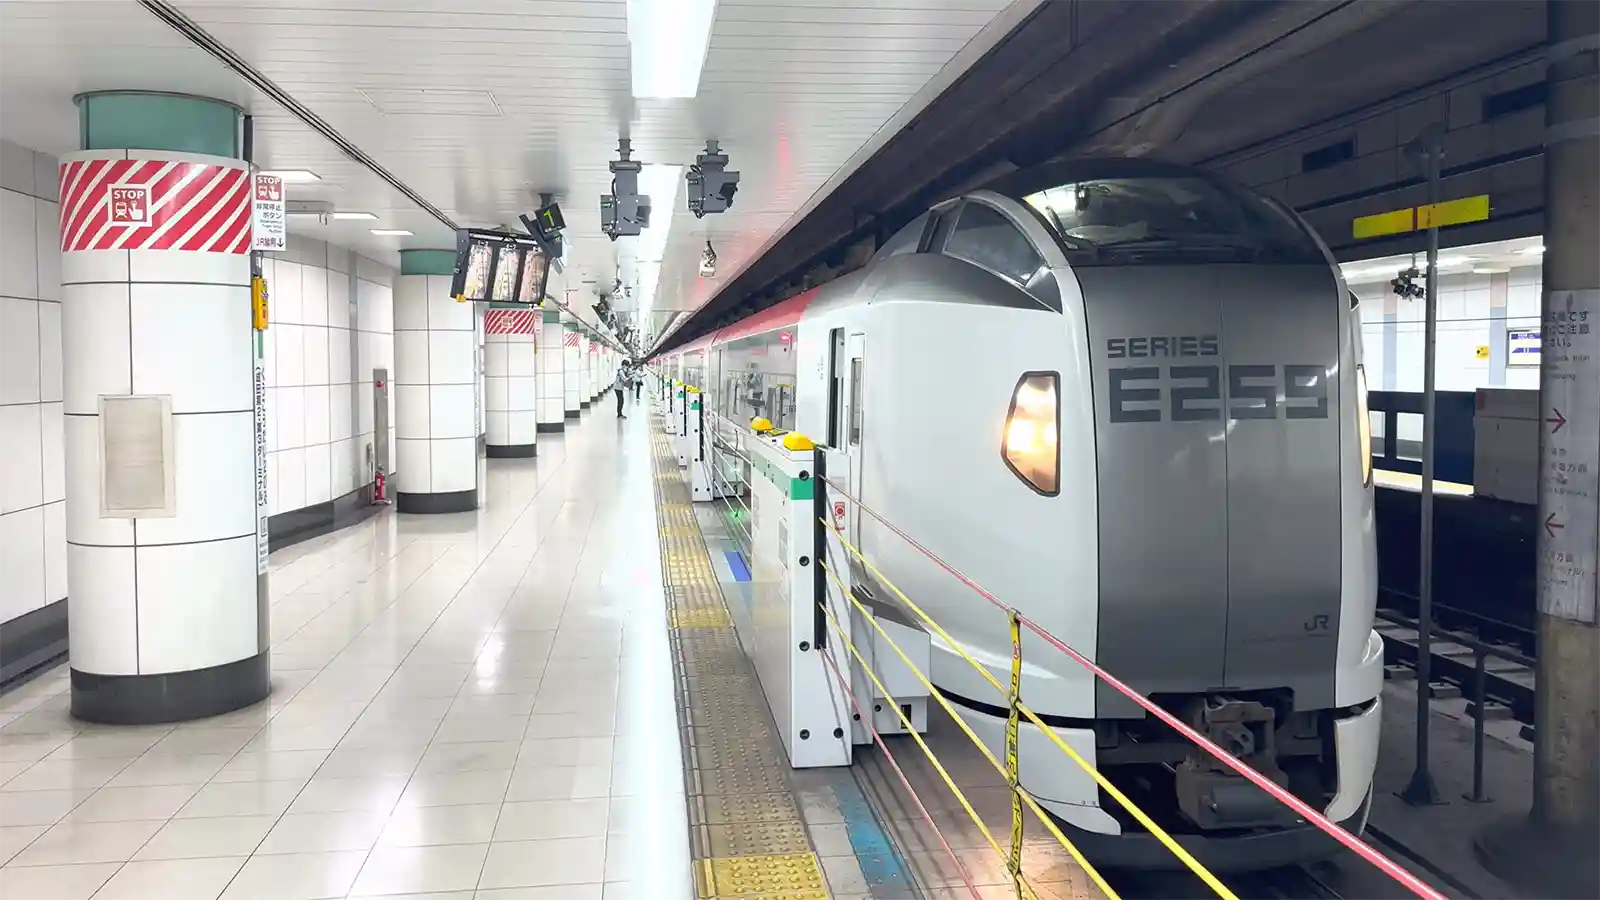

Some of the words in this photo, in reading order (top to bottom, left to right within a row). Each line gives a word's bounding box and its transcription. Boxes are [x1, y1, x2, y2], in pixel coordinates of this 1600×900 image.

[257, 176, 280, 185] STOP
[113, 190, 144, 200] STOP
[1107, 336, 1218, 358] SERIES
[1108, 364, 1329, 423] E259
[1304, 614, 1330, 632] JR
